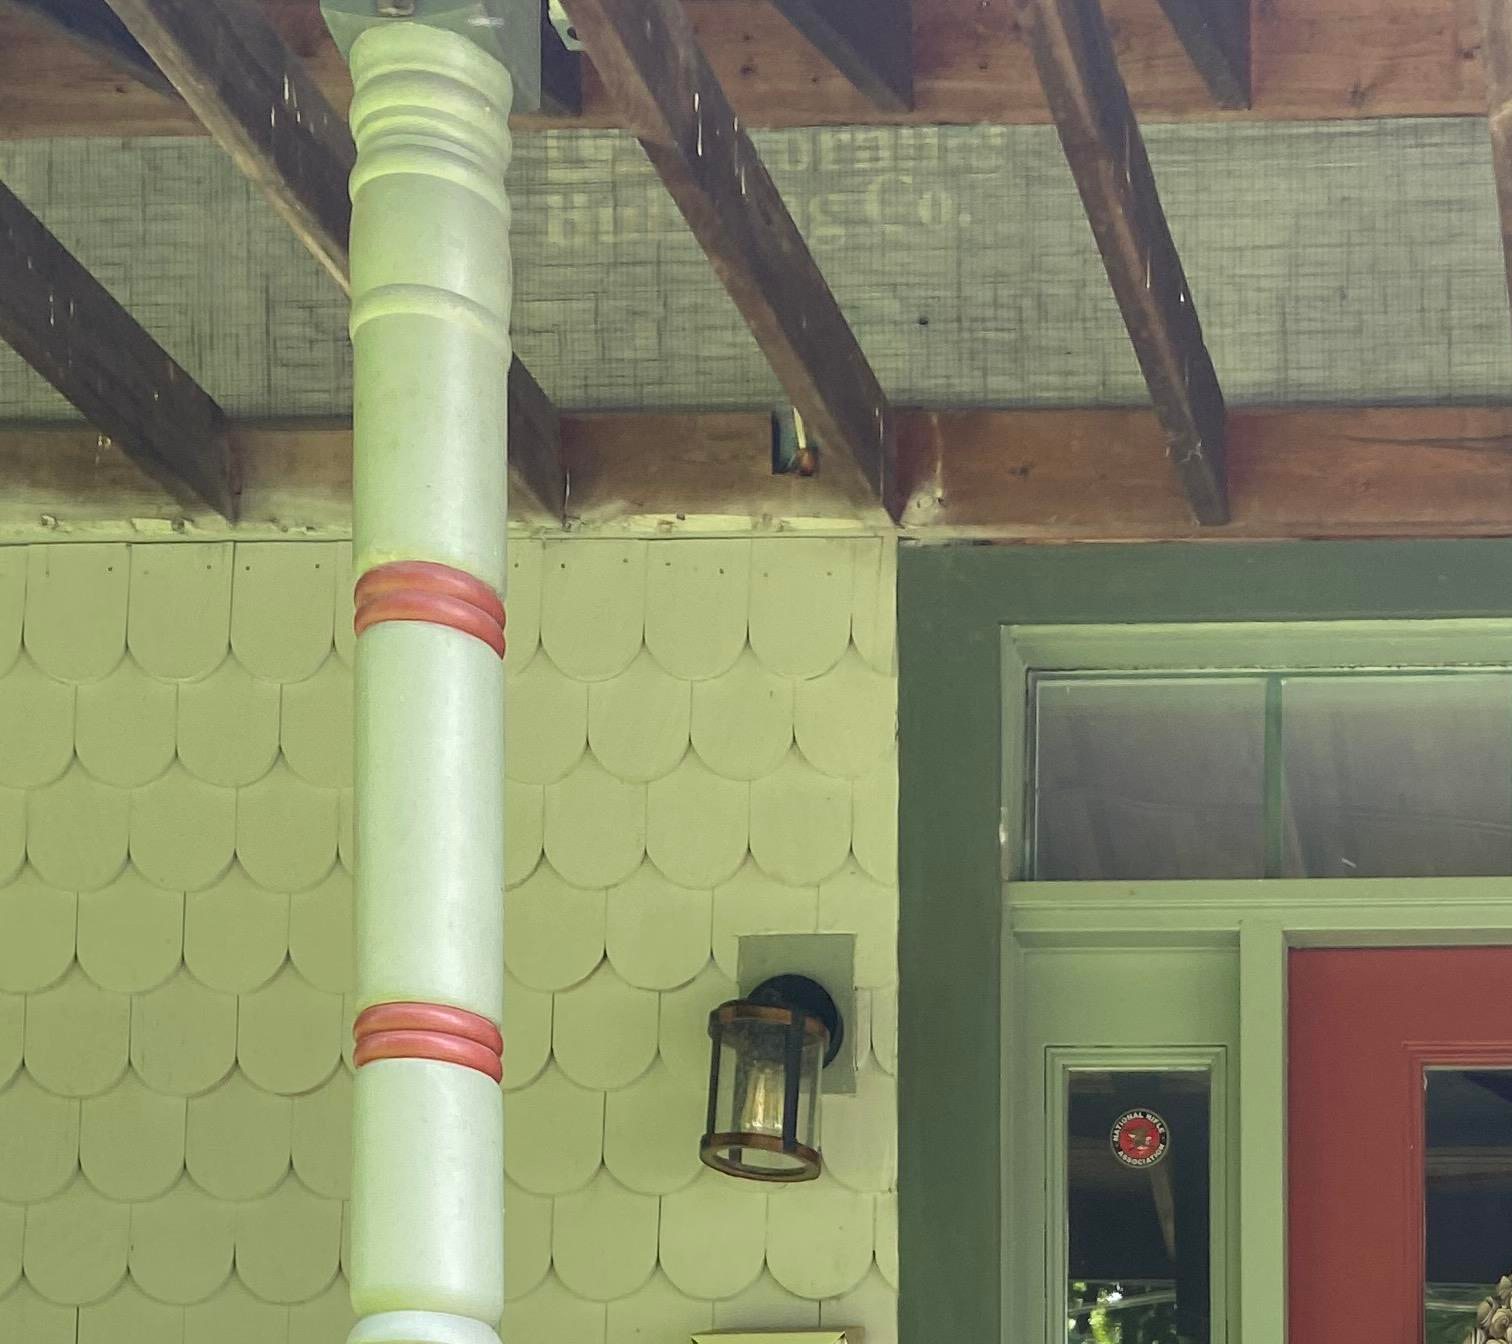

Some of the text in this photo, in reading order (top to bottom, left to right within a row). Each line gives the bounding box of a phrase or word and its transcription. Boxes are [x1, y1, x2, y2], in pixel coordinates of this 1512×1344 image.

[1113, 1112, 1164, 1142] NATIONAL RIFLE
[1118, 1143, 1164, 1165] ASSOCIATION
